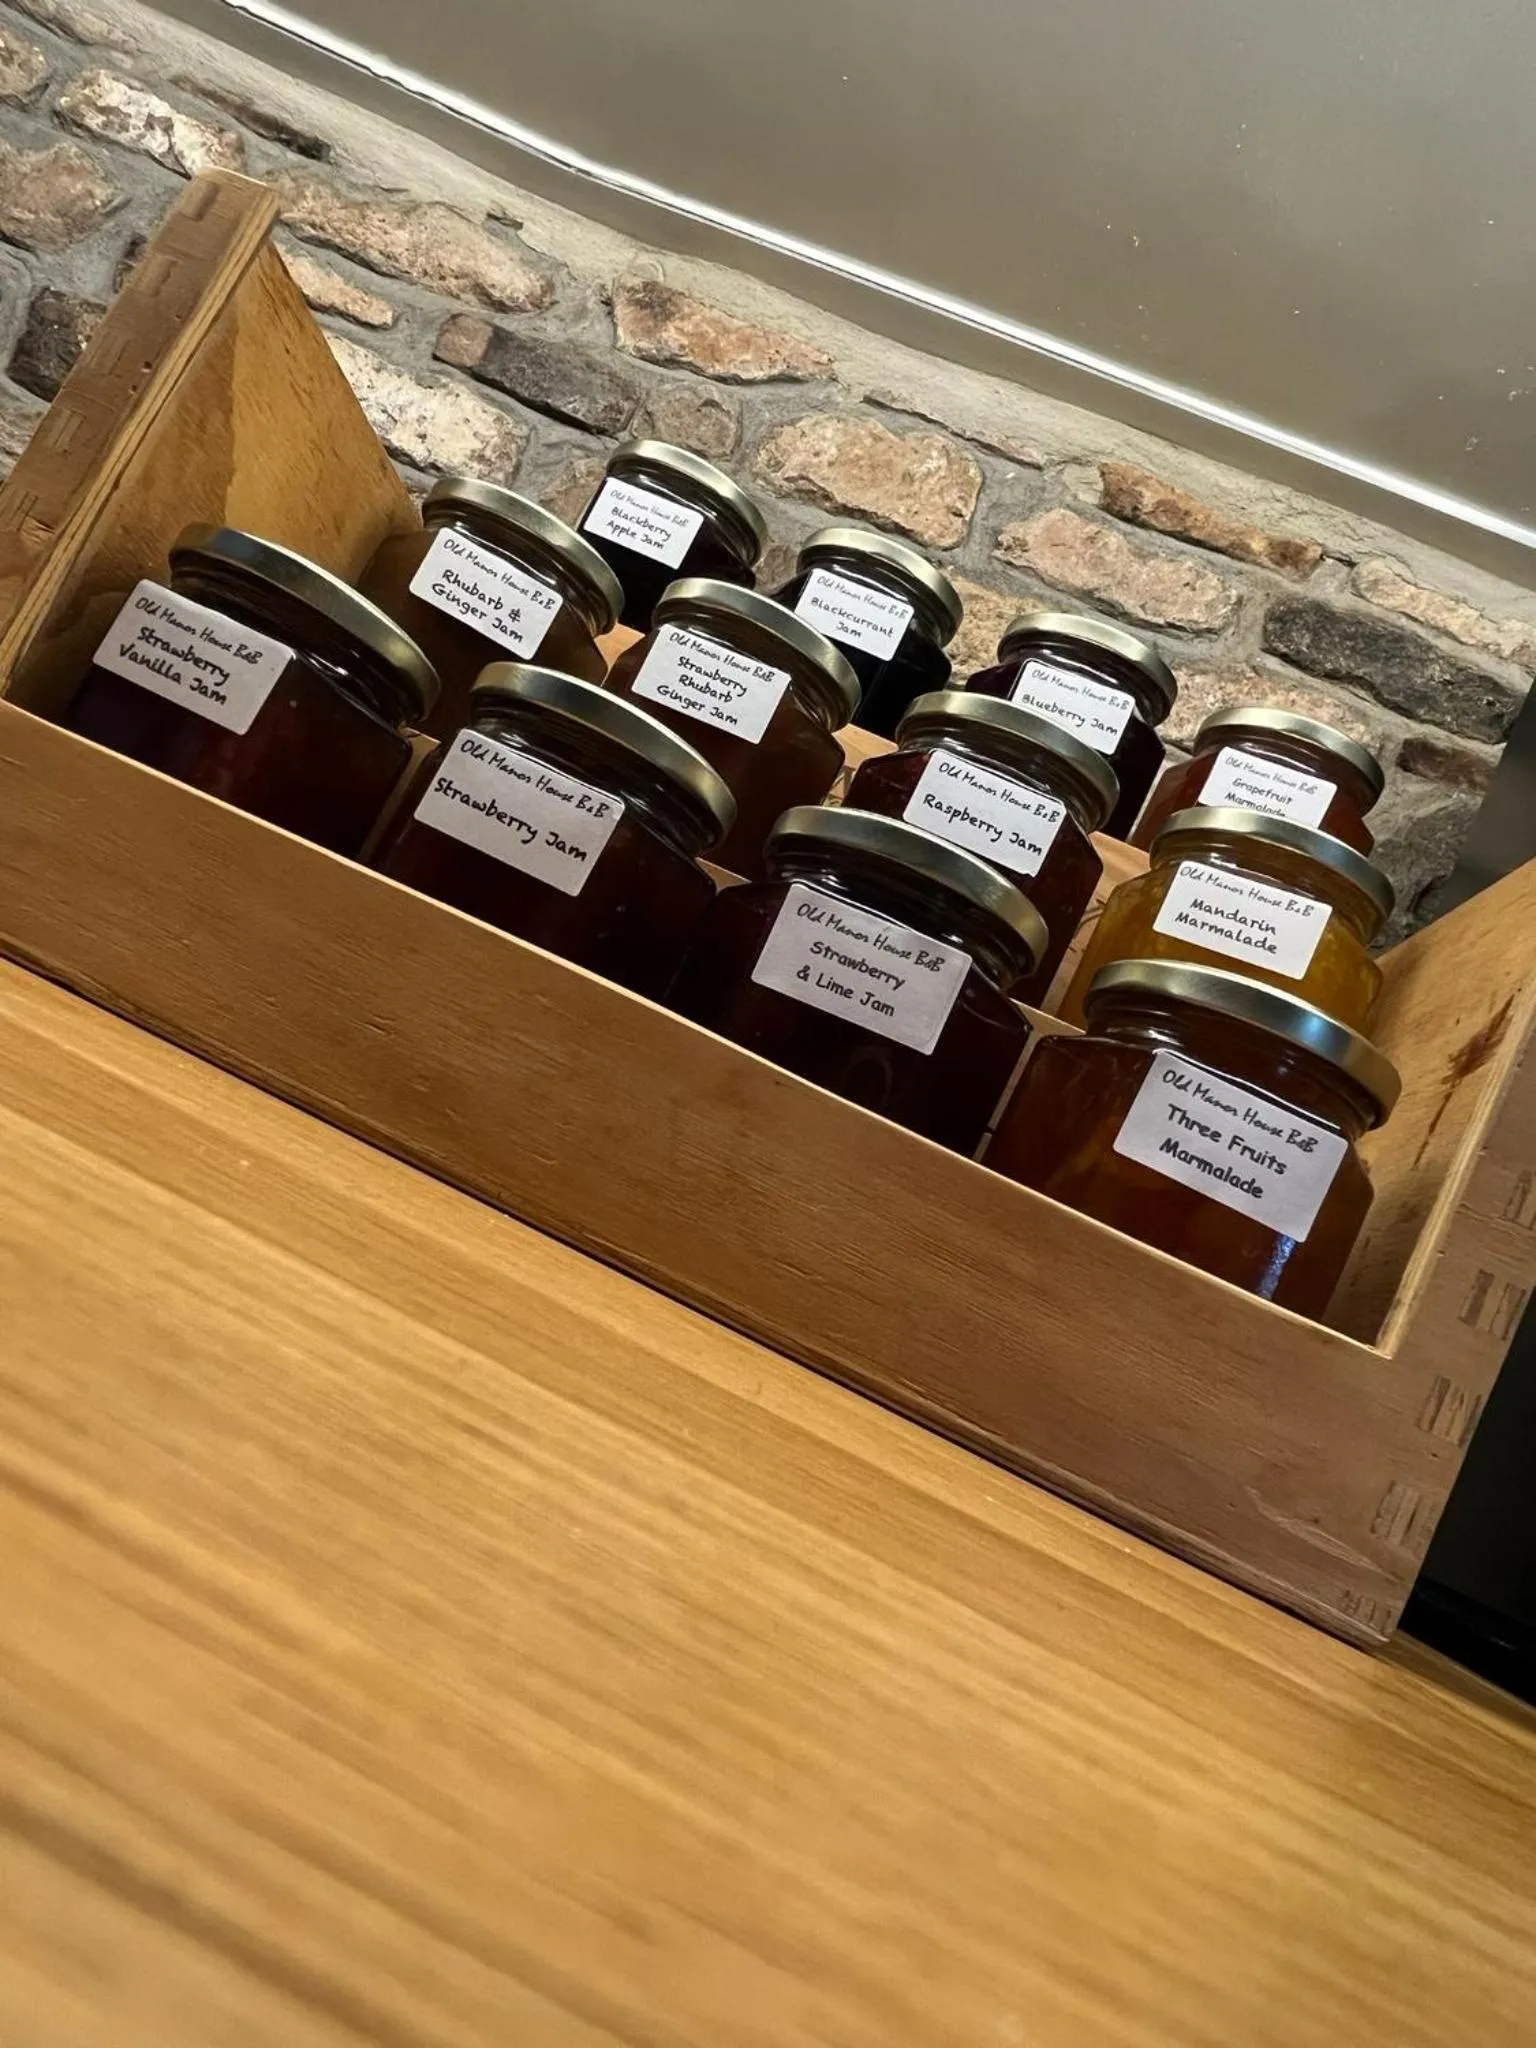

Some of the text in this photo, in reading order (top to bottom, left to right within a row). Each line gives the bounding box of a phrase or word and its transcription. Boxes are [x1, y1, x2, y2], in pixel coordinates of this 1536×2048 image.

[443, 539, 466, 556] Old
[465, 552, 498, 578] Manor
[501, 573, 529, 596] House
[432, 583, 523, 643] Ginger Jam
[442, 569, 521, 623] Rhubarb &
[135, 597, 157, 616] Old
[159, 608, 196, 635] Manor
[200, 626, 232, 652] House
[119, 643, 227, 706] Vanilla Jam
[137, 626, 231, 687] Strawberry
[669, 632, 691, 646] Old
[691, 641, 721, 662] Manor
[723, 655, 751, 672] House
[677, 656, 748, 697] Strawberry
[657, 685, 738, 726] Ginger Jam
[679, 674, 733, 703] Rhubarb
[1022, 694, 1118, 736] Blueberry Jam
[460, 739, 486, 761] Old
[488, 752, 531, 784] Manor
[535, 775, 572, 803] House
[939, 763, 962, 779] Old
[962, 772, 997, 796] Manor
[1000, 789, 1032, 810] House
[433, 777, 588, 862] Strawberry Jam
[923, 793, 1043, 856] Raspberry Jam
[1180, 866, 1206, 880] Old
[1206, 873, 1244, 896] Manor
[1248, 887, 1282, 907] House
[796, 903, 823, 923] Old
[825, 914, 869, 943] Manor
[873, 934, 912, 960] House
[1175, 912, 1278, 954] Marmalade
[1190, 898, 1276, 935] Mandarin
[796, 965, 895, 1017] & Lime Jam
[809, 941, 906, 991] Strawberry
[1162, 1069, 1189, 1092] Old
[1192, 1082, 1239, 1117] Manor
[1242, 1108, 1284, 1138] House
[1168, 1104, 1288, 1175] Three Fruits
[1159, 1138, 1264, 1200] Marmalade
